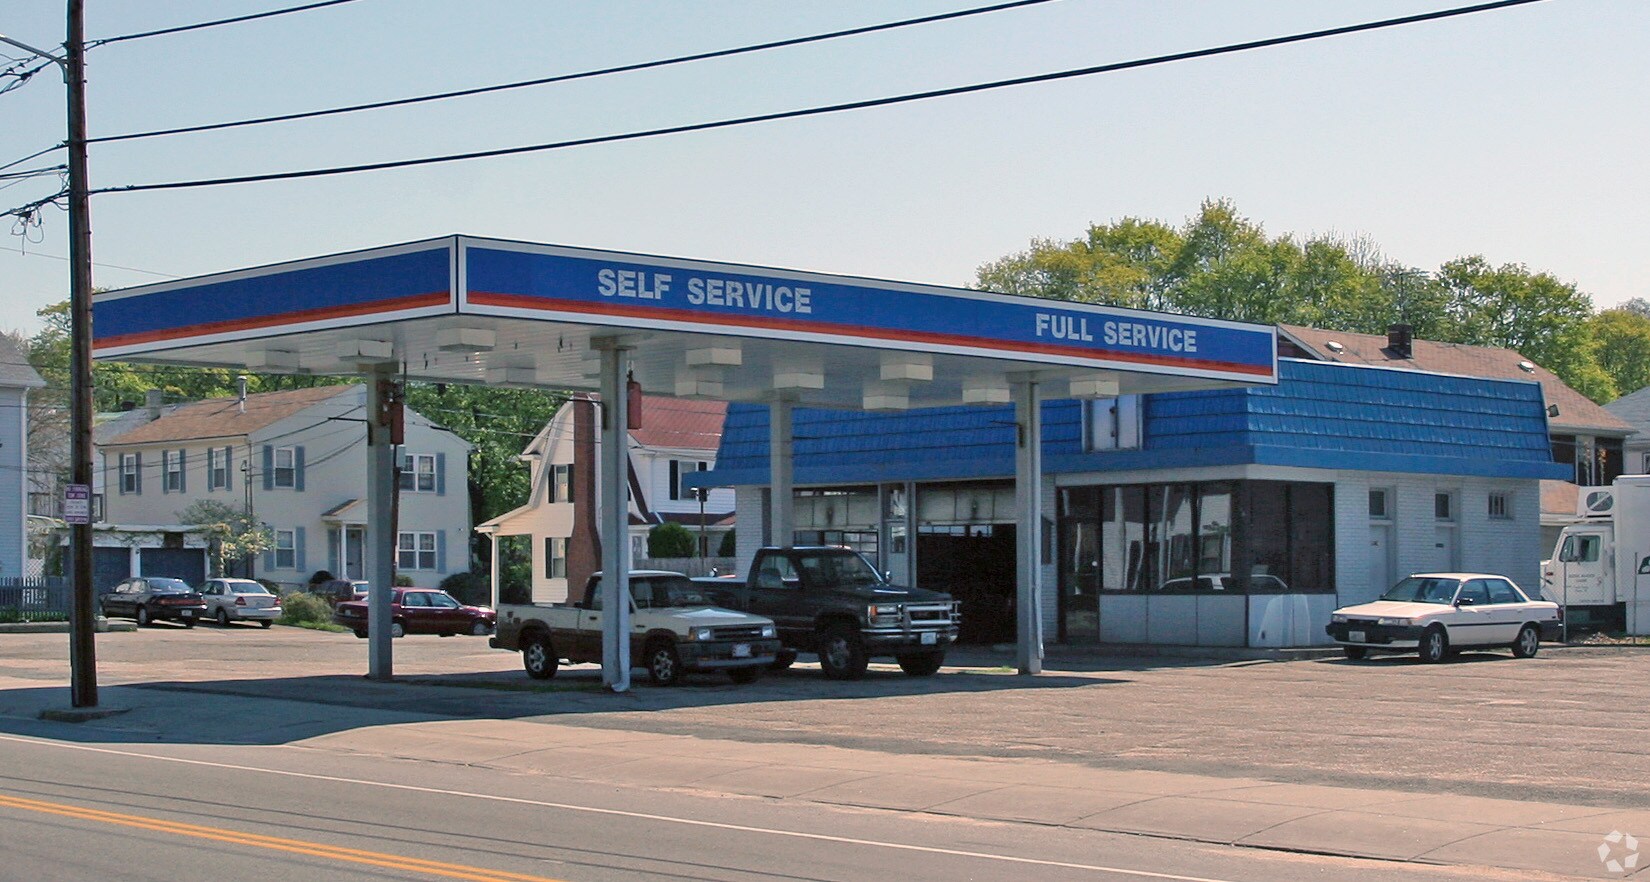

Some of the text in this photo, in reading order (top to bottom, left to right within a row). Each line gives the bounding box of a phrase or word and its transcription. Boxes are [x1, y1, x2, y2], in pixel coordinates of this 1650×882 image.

[598, 269, 811, 314] SELF SERVICE
[1036, 313, 1197, 352] FULL SERVICE
